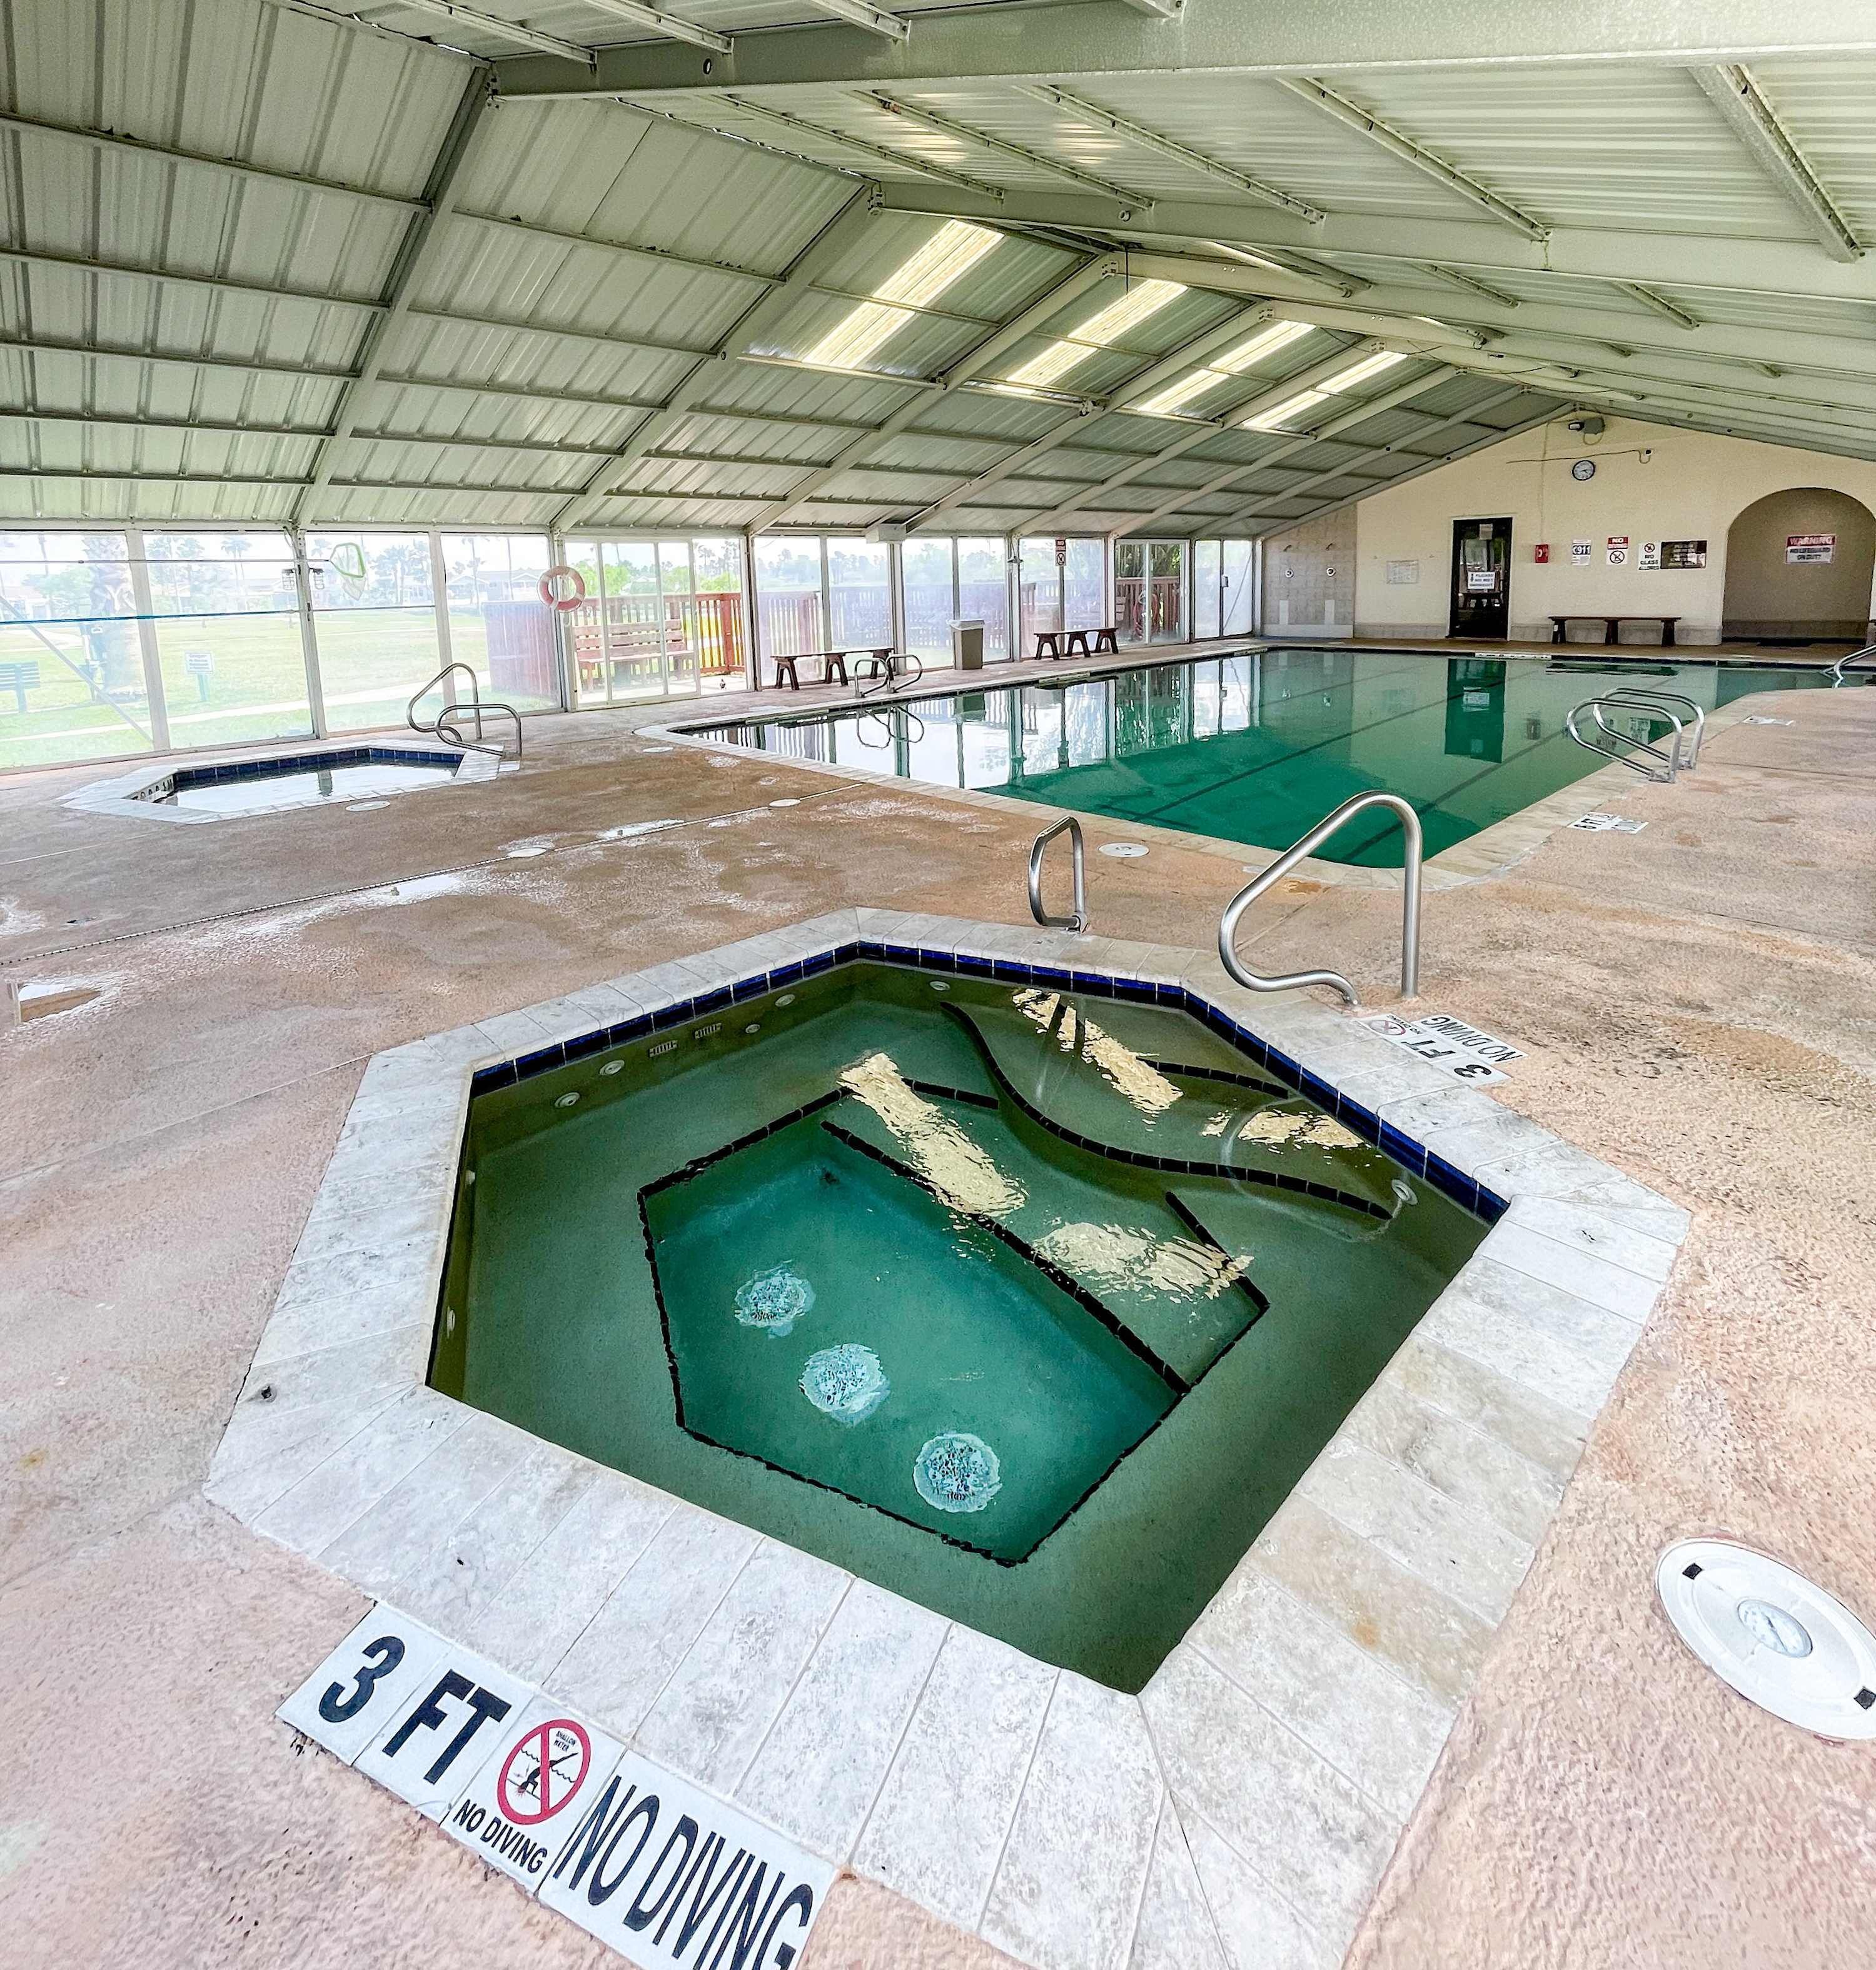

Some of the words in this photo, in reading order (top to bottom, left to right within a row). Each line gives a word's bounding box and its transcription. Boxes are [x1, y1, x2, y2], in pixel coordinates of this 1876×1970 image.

[1790, 536, 1832, 546] WARNING
[1420, 1017, 1493, 1047] DIVING
[1401, 1040, 1456, 1058] FT
[1478, 1045, 1523, 1062] NO
[1453, 1064, 1492, 1078] 3
[318, 1636, 405, 1723] 3
[381, 1668, 512, 1786] FT
[452, 1799, 487, 1832] NO
[480, 1816, 548, 1873] DIVING
[553, 1775, 660, 1906] NO
[622, 1814, 814, 1970] DIVING
